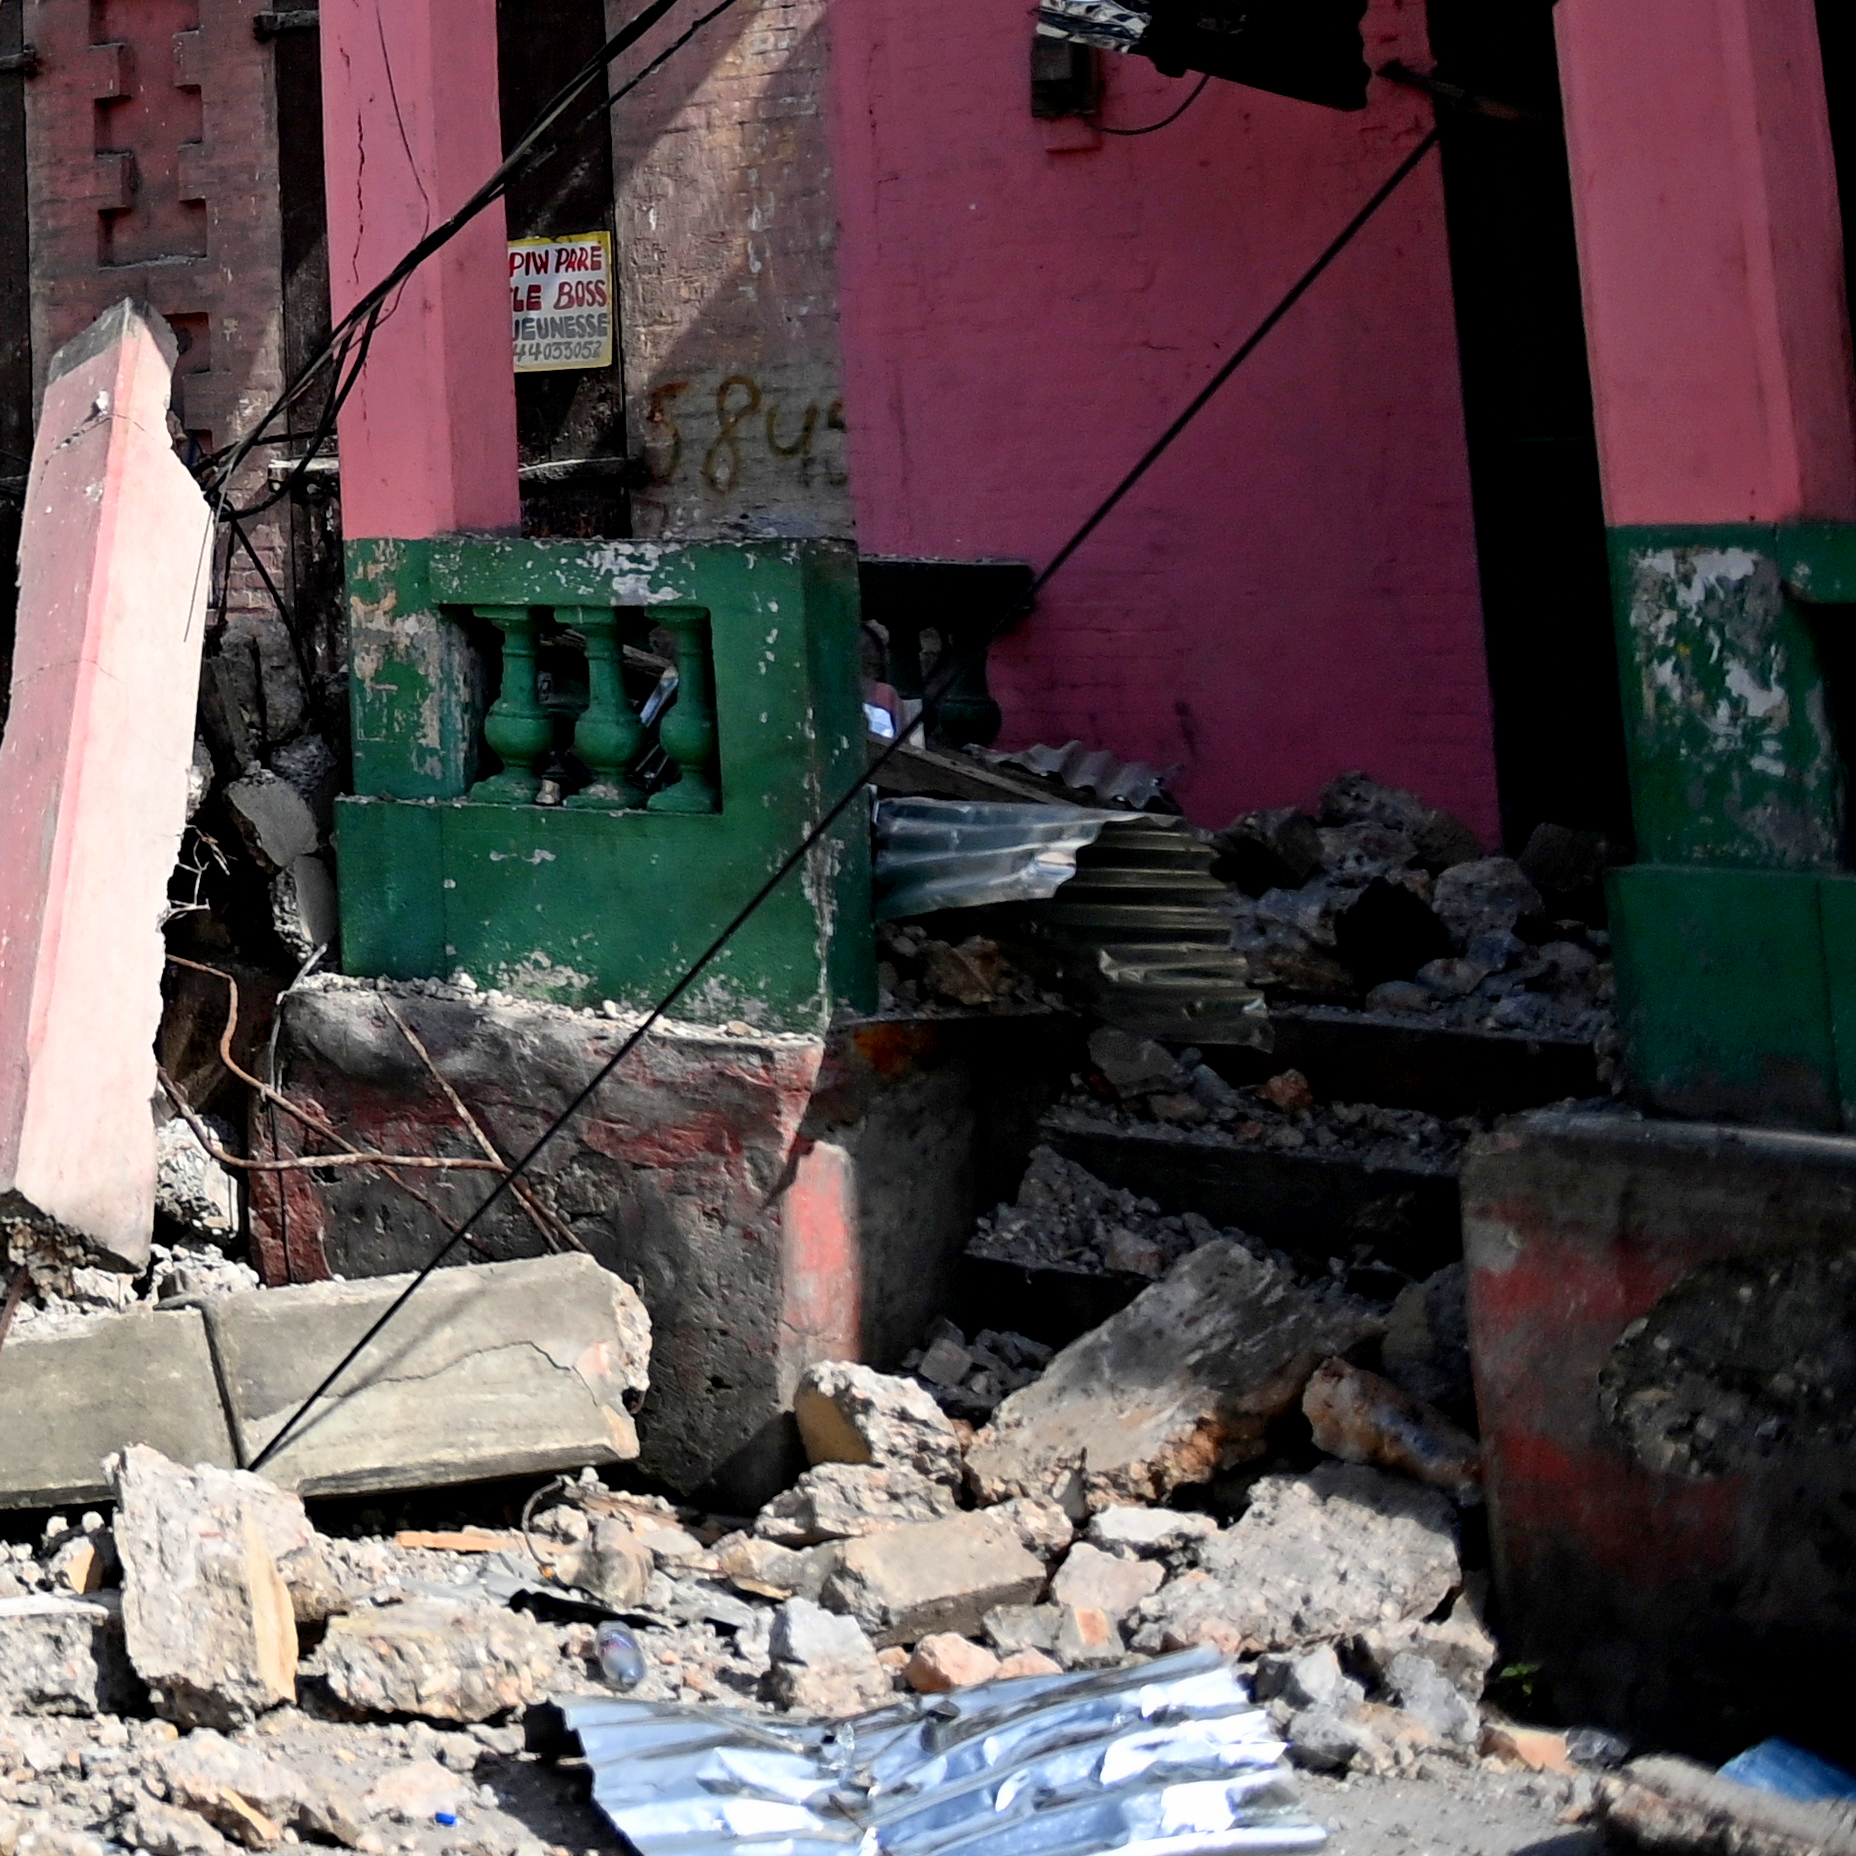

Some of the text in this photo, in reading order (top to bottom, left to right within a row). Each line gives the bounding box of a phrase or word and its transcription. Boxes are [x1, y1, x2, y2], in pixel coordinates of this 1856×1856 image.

[555, 246, 602, 273] PARE
[510, 279, 608, 312] LE BOSS
[513, 312, 608, 341] JEUNESSE
